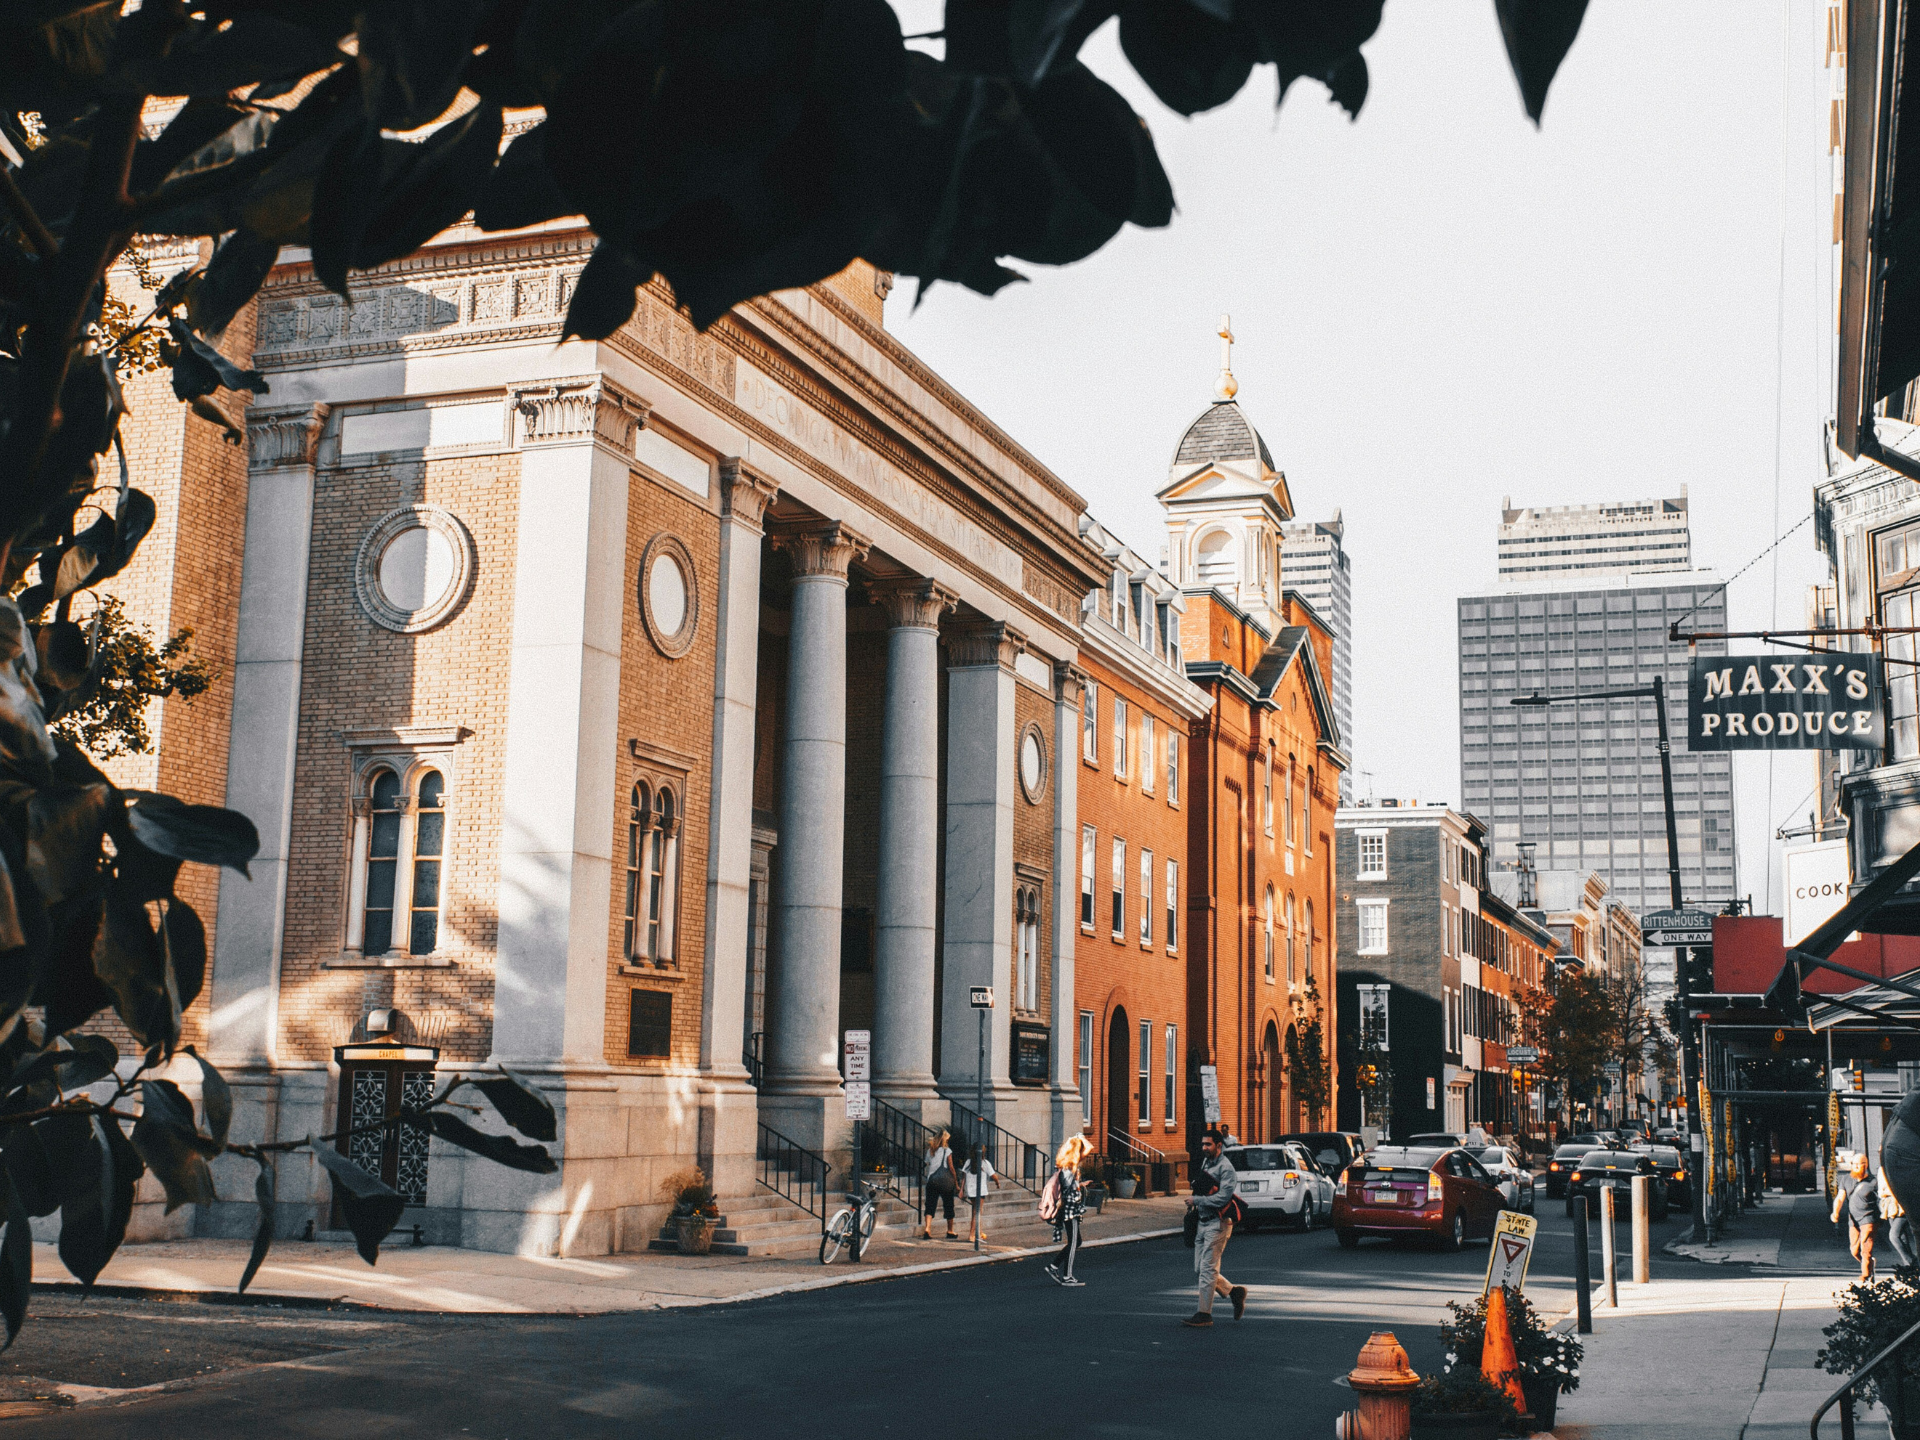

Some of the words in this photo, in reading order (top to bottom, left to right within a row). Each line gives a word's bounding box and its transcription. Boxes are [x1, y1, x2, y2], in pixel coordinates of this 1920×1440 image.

[1703, 664, 1868, 702] MAXX'S
[1701, 711, 1873, 736] PRODUCE
[1796, 882, 1843, 899] COOK
[1643, 915, 1705, 928] RITTENHOUSE
[1663, 933, 1684, 941] ONE
[1687, 933, 1708, 941] WAY
[378, 1050, 398, 1058] CHAPEL
[1506, 1215, 1530, 1227] STATE
[1508, 1225, 1525, 1234] LAW
